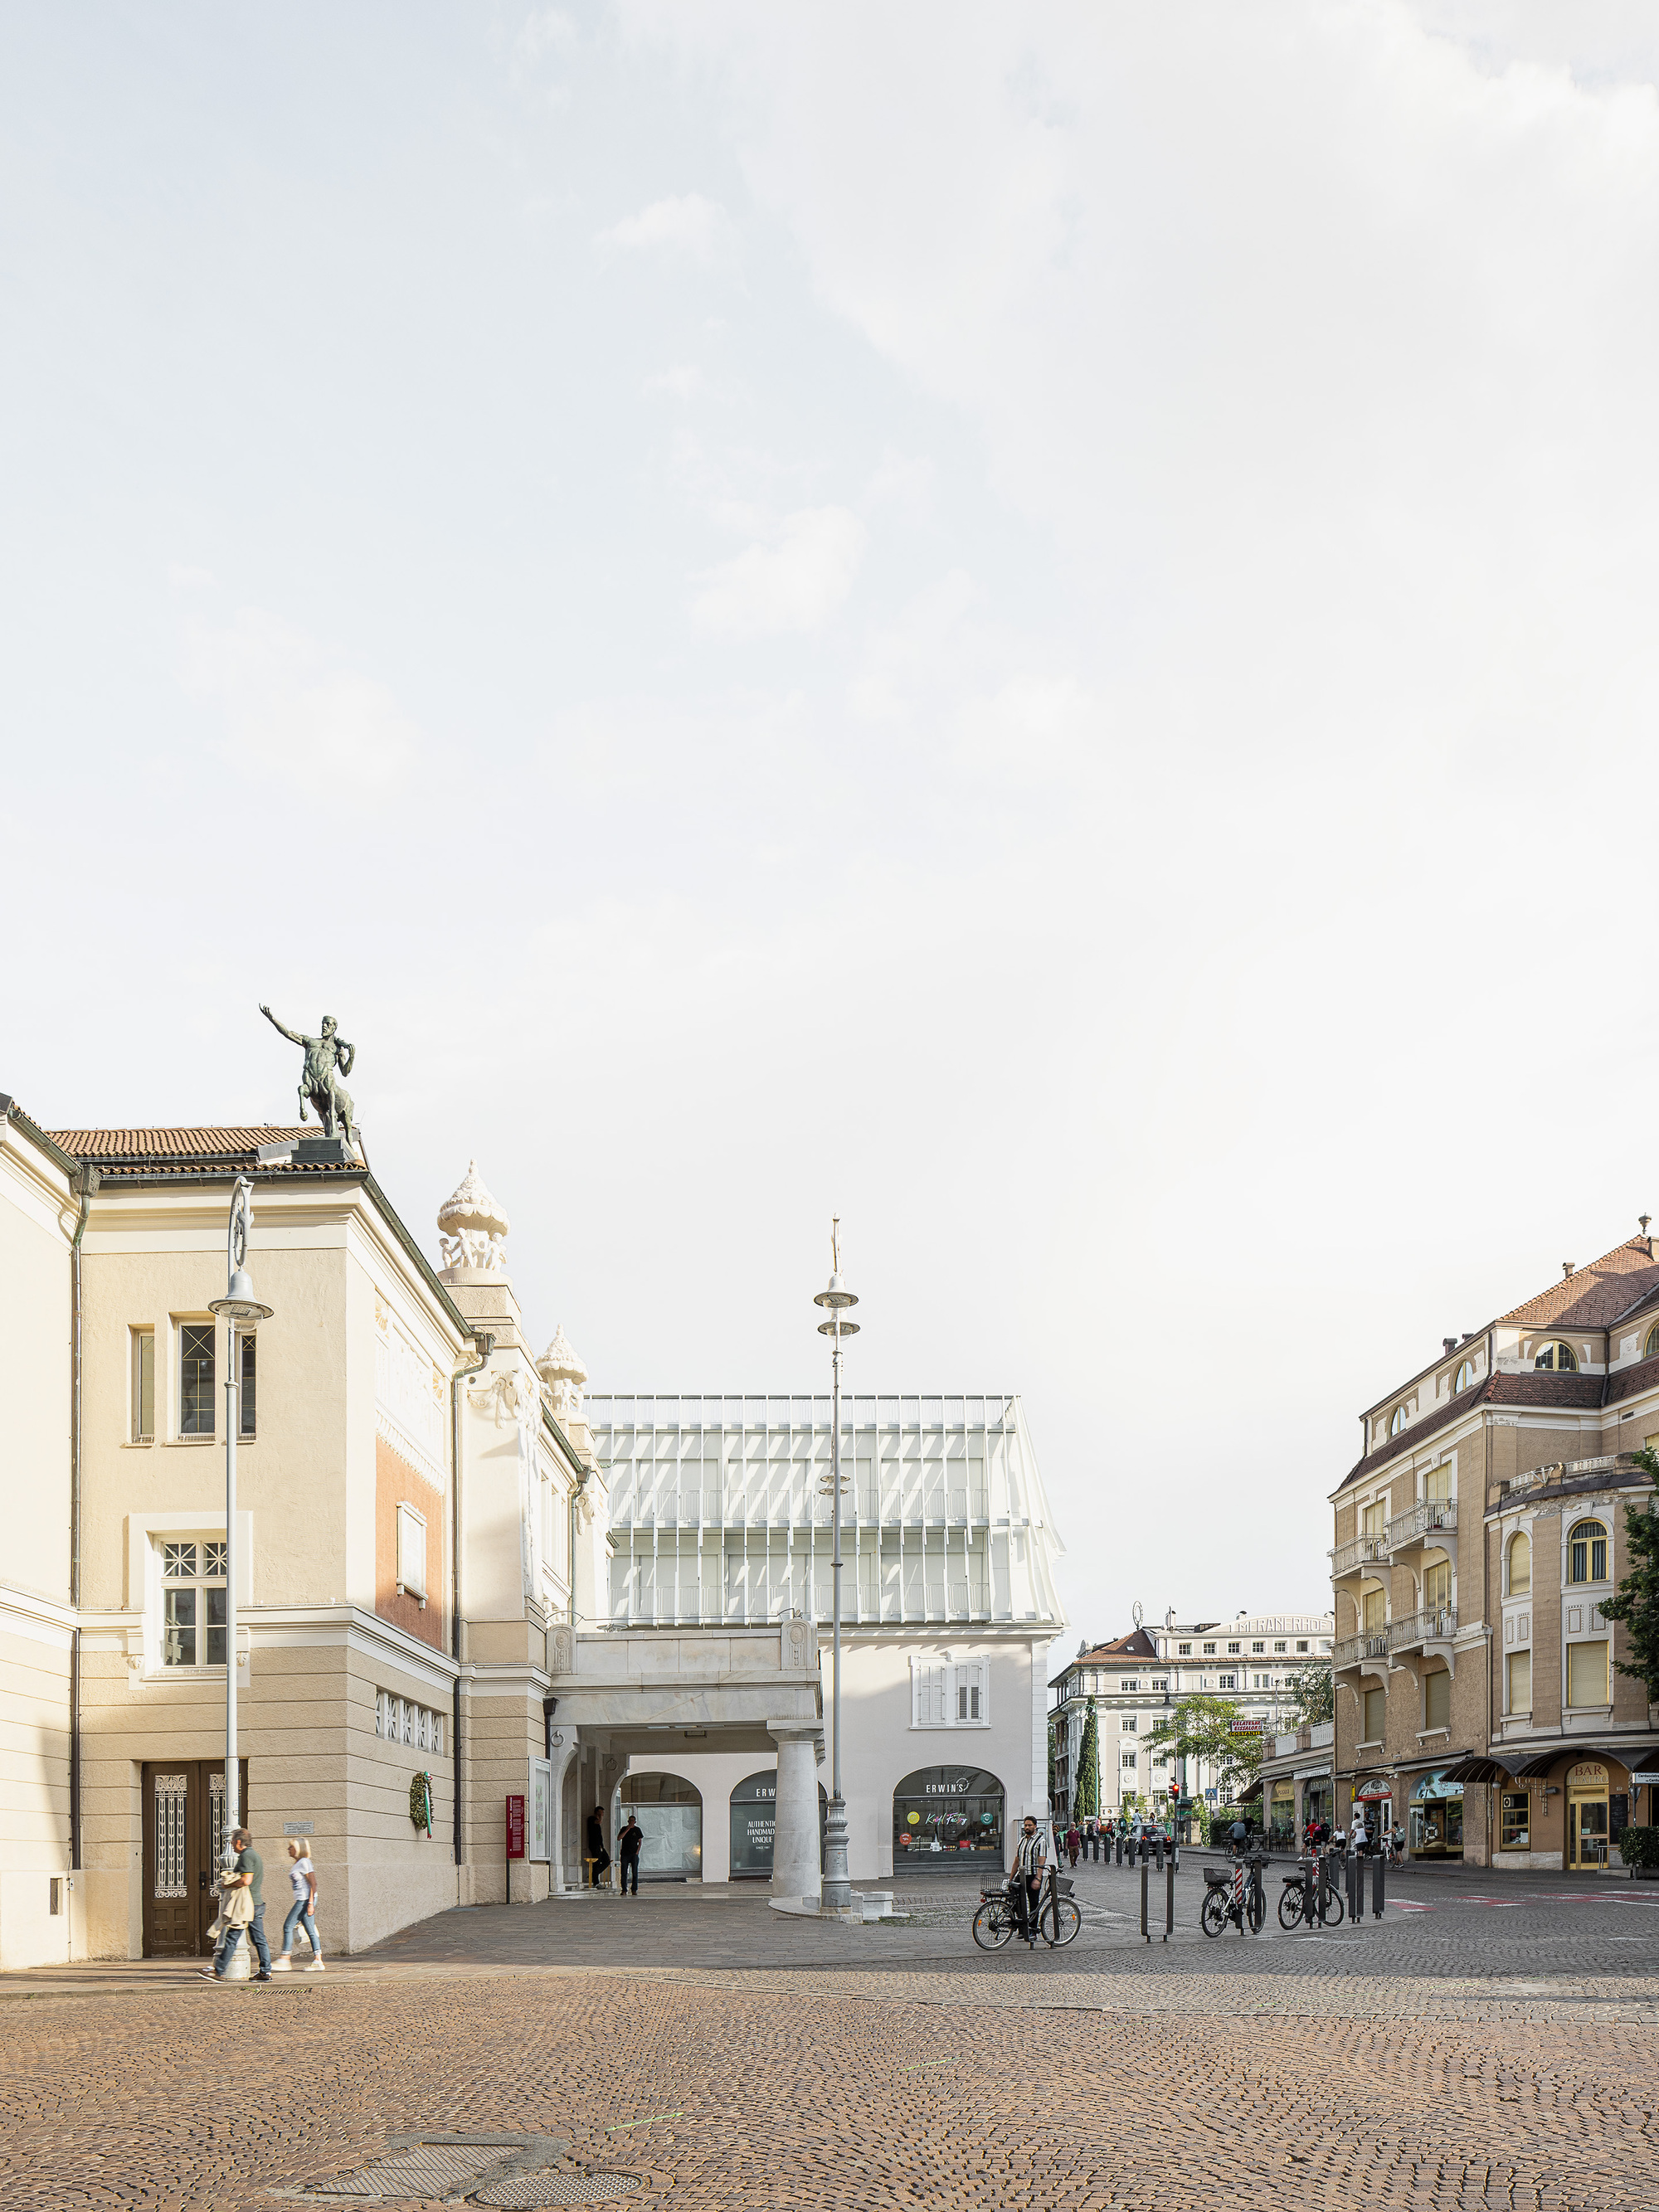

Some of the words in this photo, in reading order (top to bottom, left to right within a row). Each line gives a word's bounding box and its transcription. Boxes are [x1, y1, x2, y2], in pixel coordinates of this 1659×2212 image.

[1238, 1617, 1327, 1633] MERANERHOF
[1574, 1765, 1603, 1776] BAR
[1568, 1775, 1608, 1785] TEATRO
[756, 1788, 776, 1796] ERW
[926, 1783, 963, 1793] ERWIN'S
[752, 1835, 773, 1844] UNIQUE
